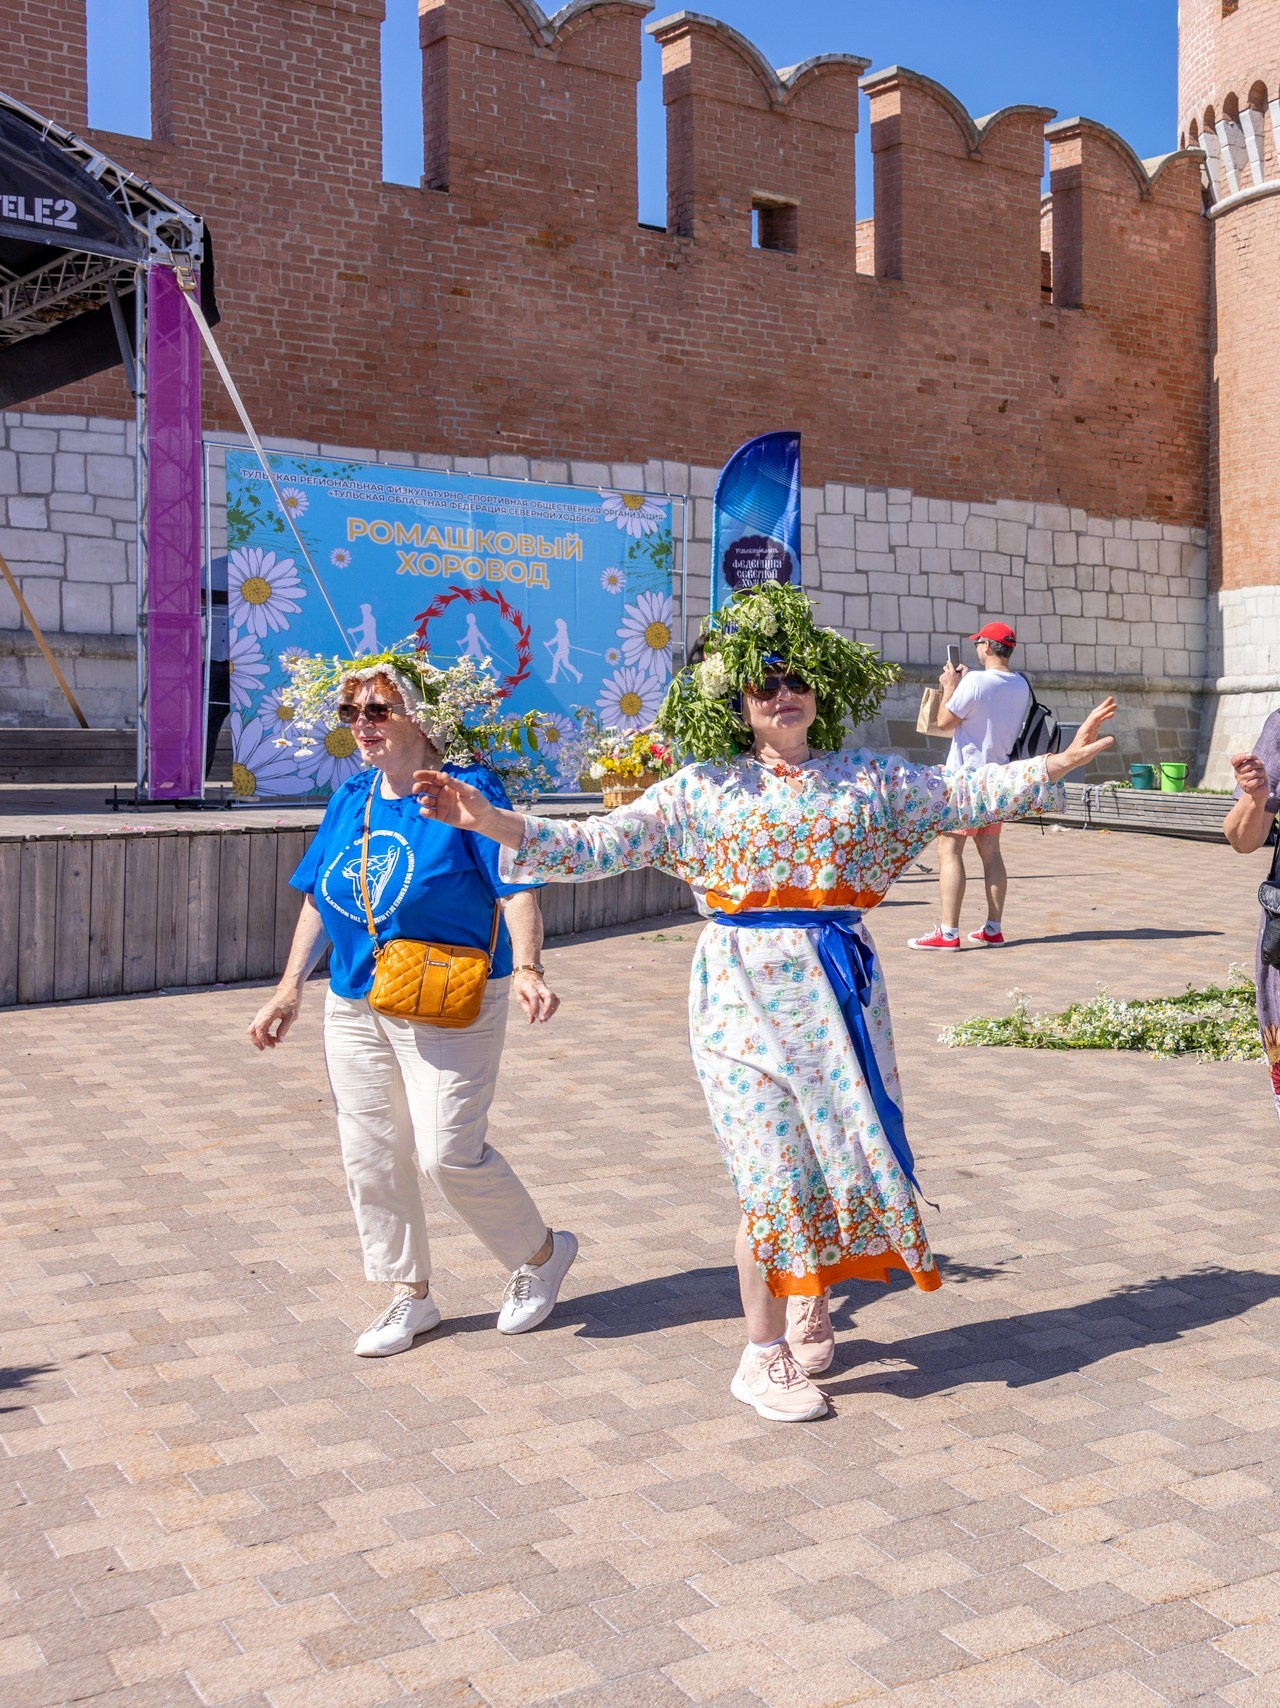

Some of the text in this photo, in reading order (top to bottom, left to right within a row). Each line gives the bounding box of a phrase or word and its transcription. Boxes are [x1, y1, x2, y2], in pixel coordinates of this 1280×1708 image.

[0, 194, 77, 230] ELE2
[241, 469, 663, 521] ТУЛЬКАЯ РЕГИОНАЛЬНАЯ ФИЗКУЛЬТУРНО-СПОРТИВНАЯ ОБЩЕСТВЕННАЯ ОРГАНИЗАЦИЯ
[328, 489, 599, 524] «ТУЛЬСКАЯ ОБЛАСТНАЯ ФЕДЕРАЦИЯ СЕВЕРНОЙ ХОДЬБЫ»
[347, 517, 583, 561] РОМАШКОВЫЙ
[396, 550, 550, 589] ХОРОВОД
